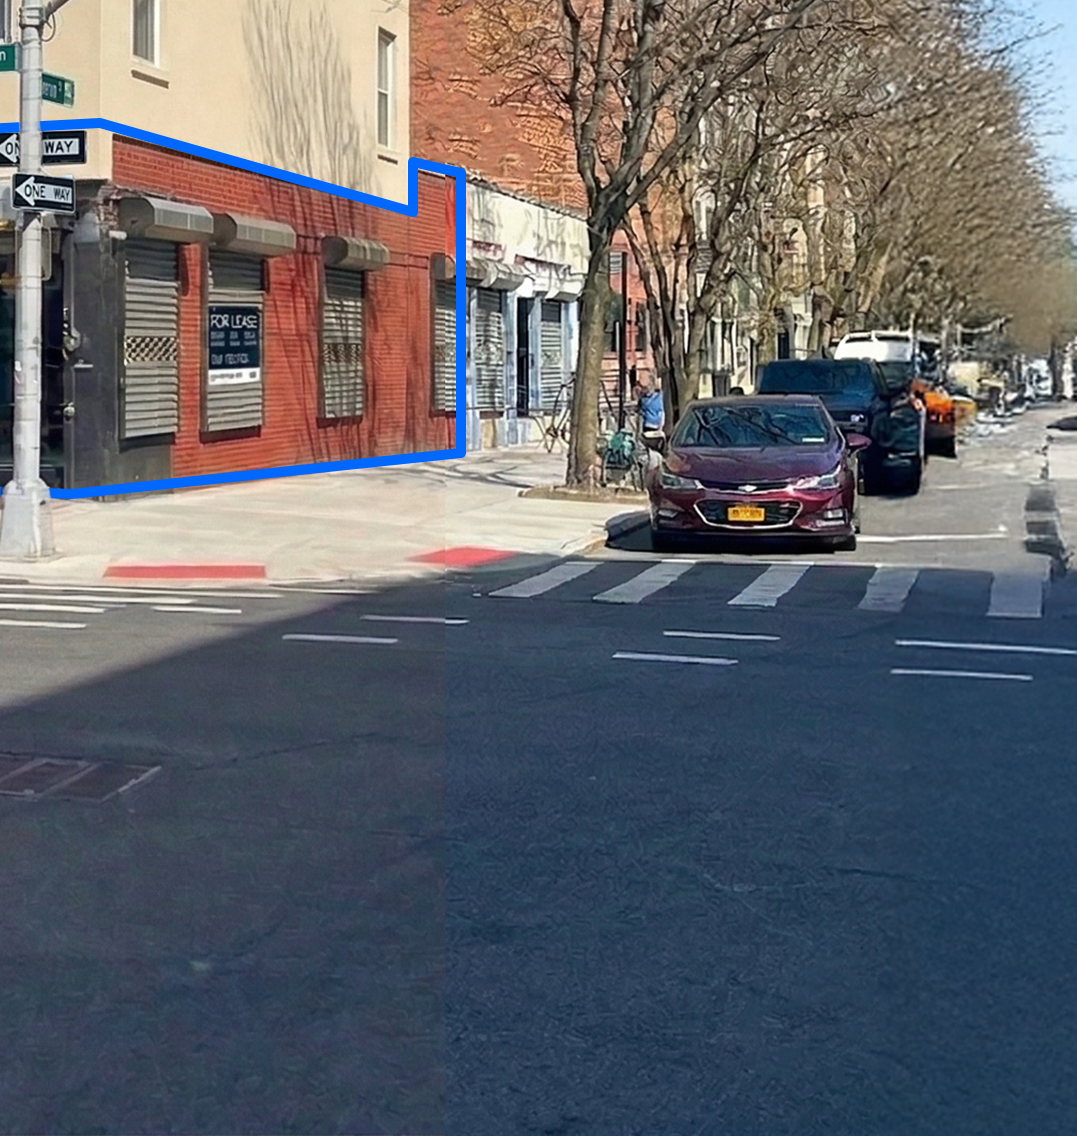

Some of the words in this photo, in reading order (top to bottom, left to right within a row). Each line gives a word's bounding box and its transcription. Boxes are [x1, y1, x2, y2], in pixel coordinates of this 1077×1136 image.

[44, 140, 74, 154] WAY
[24, 184, 46, 199] ONE
[53, 187, 71, 201] WAY
